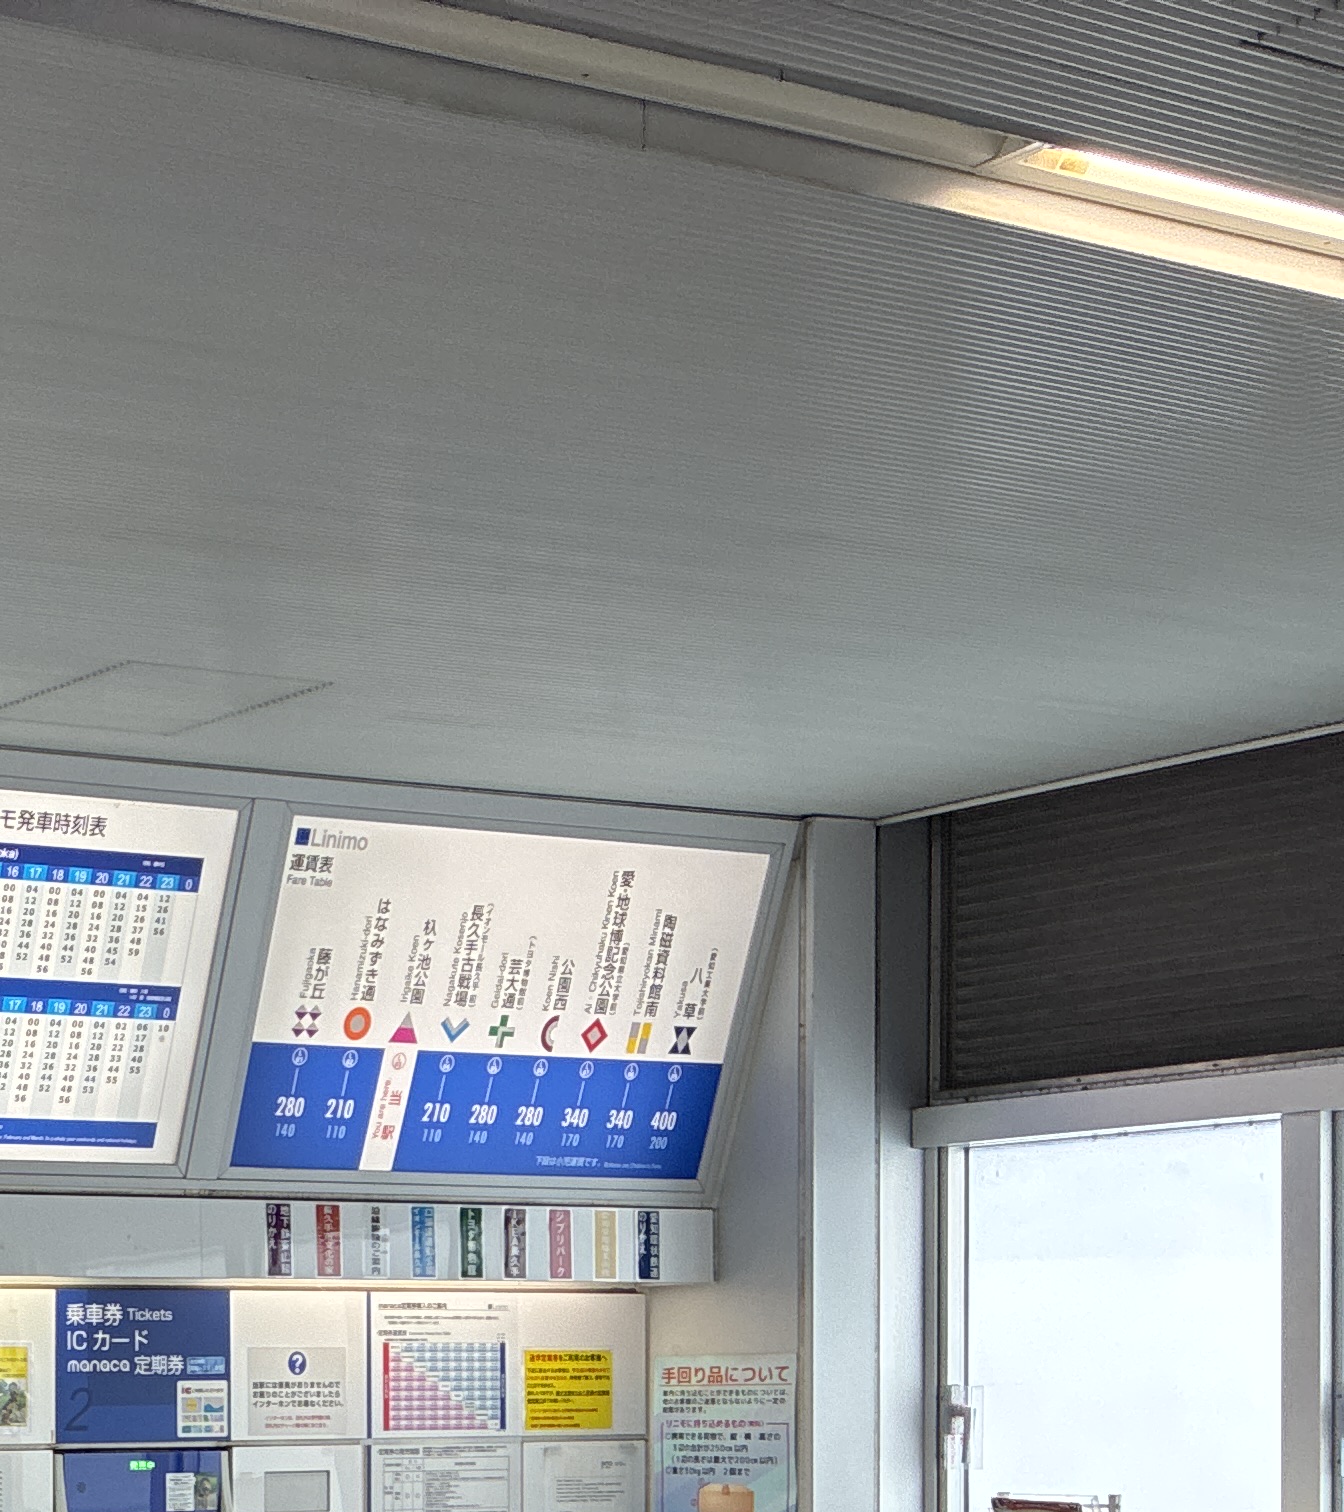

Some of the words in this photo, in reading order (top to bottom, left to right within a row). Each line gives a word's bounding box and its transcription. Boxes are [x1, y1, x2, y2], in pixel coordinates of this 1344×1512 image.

[311, 829, 368, 851] Linimo
[289, 854, 334, 874] 運賃表
[6, 865, 19, 877] 16
[29, 867, 42, 879] 17
[51, 868, 64, 881] 18
[74, 870, 87, 882] 19
[95, 872, 109, 884] 20
[117, 873, 130, 885] 21
[139, 875, 152, 887] 22
[161, 877, 174, 889] 23
[185, 879, 193, 890] 0
[286, 875, 307, 885] Fare
[310, 876, 333, 887] Table
[360, 898, 391, 1001] はなみずき通
[453, 905, 484, 1007] 長久手古戦場
[300, 948, 316, 999] Fujigaoka
[310, 948, 333, 999] 藤が丘
[501, 958, 523, 1010] 芸大通
[553, 959, 575, 1011] 公園西
[275, 1096, 305, 1118] 280
[324, 1098, 355, 1119] 210
[421, 1103, 451, 1123] 210
[469, 1104, 498, 1125] 280
[515, 1106, 544, 1127] 280
[561, 1108, 589, 1128] 340
[606, 1110, 634, 1129] 340
[650, 1111, 678, 1131] 400
[275, 1123, 296, 1137] 140
[325, 1125, 346, 1139] 110
[422, 1128, 442, 1142] 110
[468, 1130, 488, 1144] 140
[515, 1132, 534, 1146] 140
[561, 1133, 580, 1147] 170
[606, 1134, 625, 1149] 170
[649, 1136, 668, 1150] 200
[267, 1204, 278, 1249] のりかえ
[556, 1212, 566, 1277] ジブリパーク
[66, 1303, 123, 1327] 乗車券
[127, 1308, 172, 1321] Tickets
[67, 1330, 87, 1350] IC
[93, 1330, 149, 1351] カード
[67, 1359, 130, 1373] manaca
[134, 1356, 184, 1375] 定期券
[662, 1365, 790, 1384] 手回り品について
[64, 1387, 90, 1432] 2
